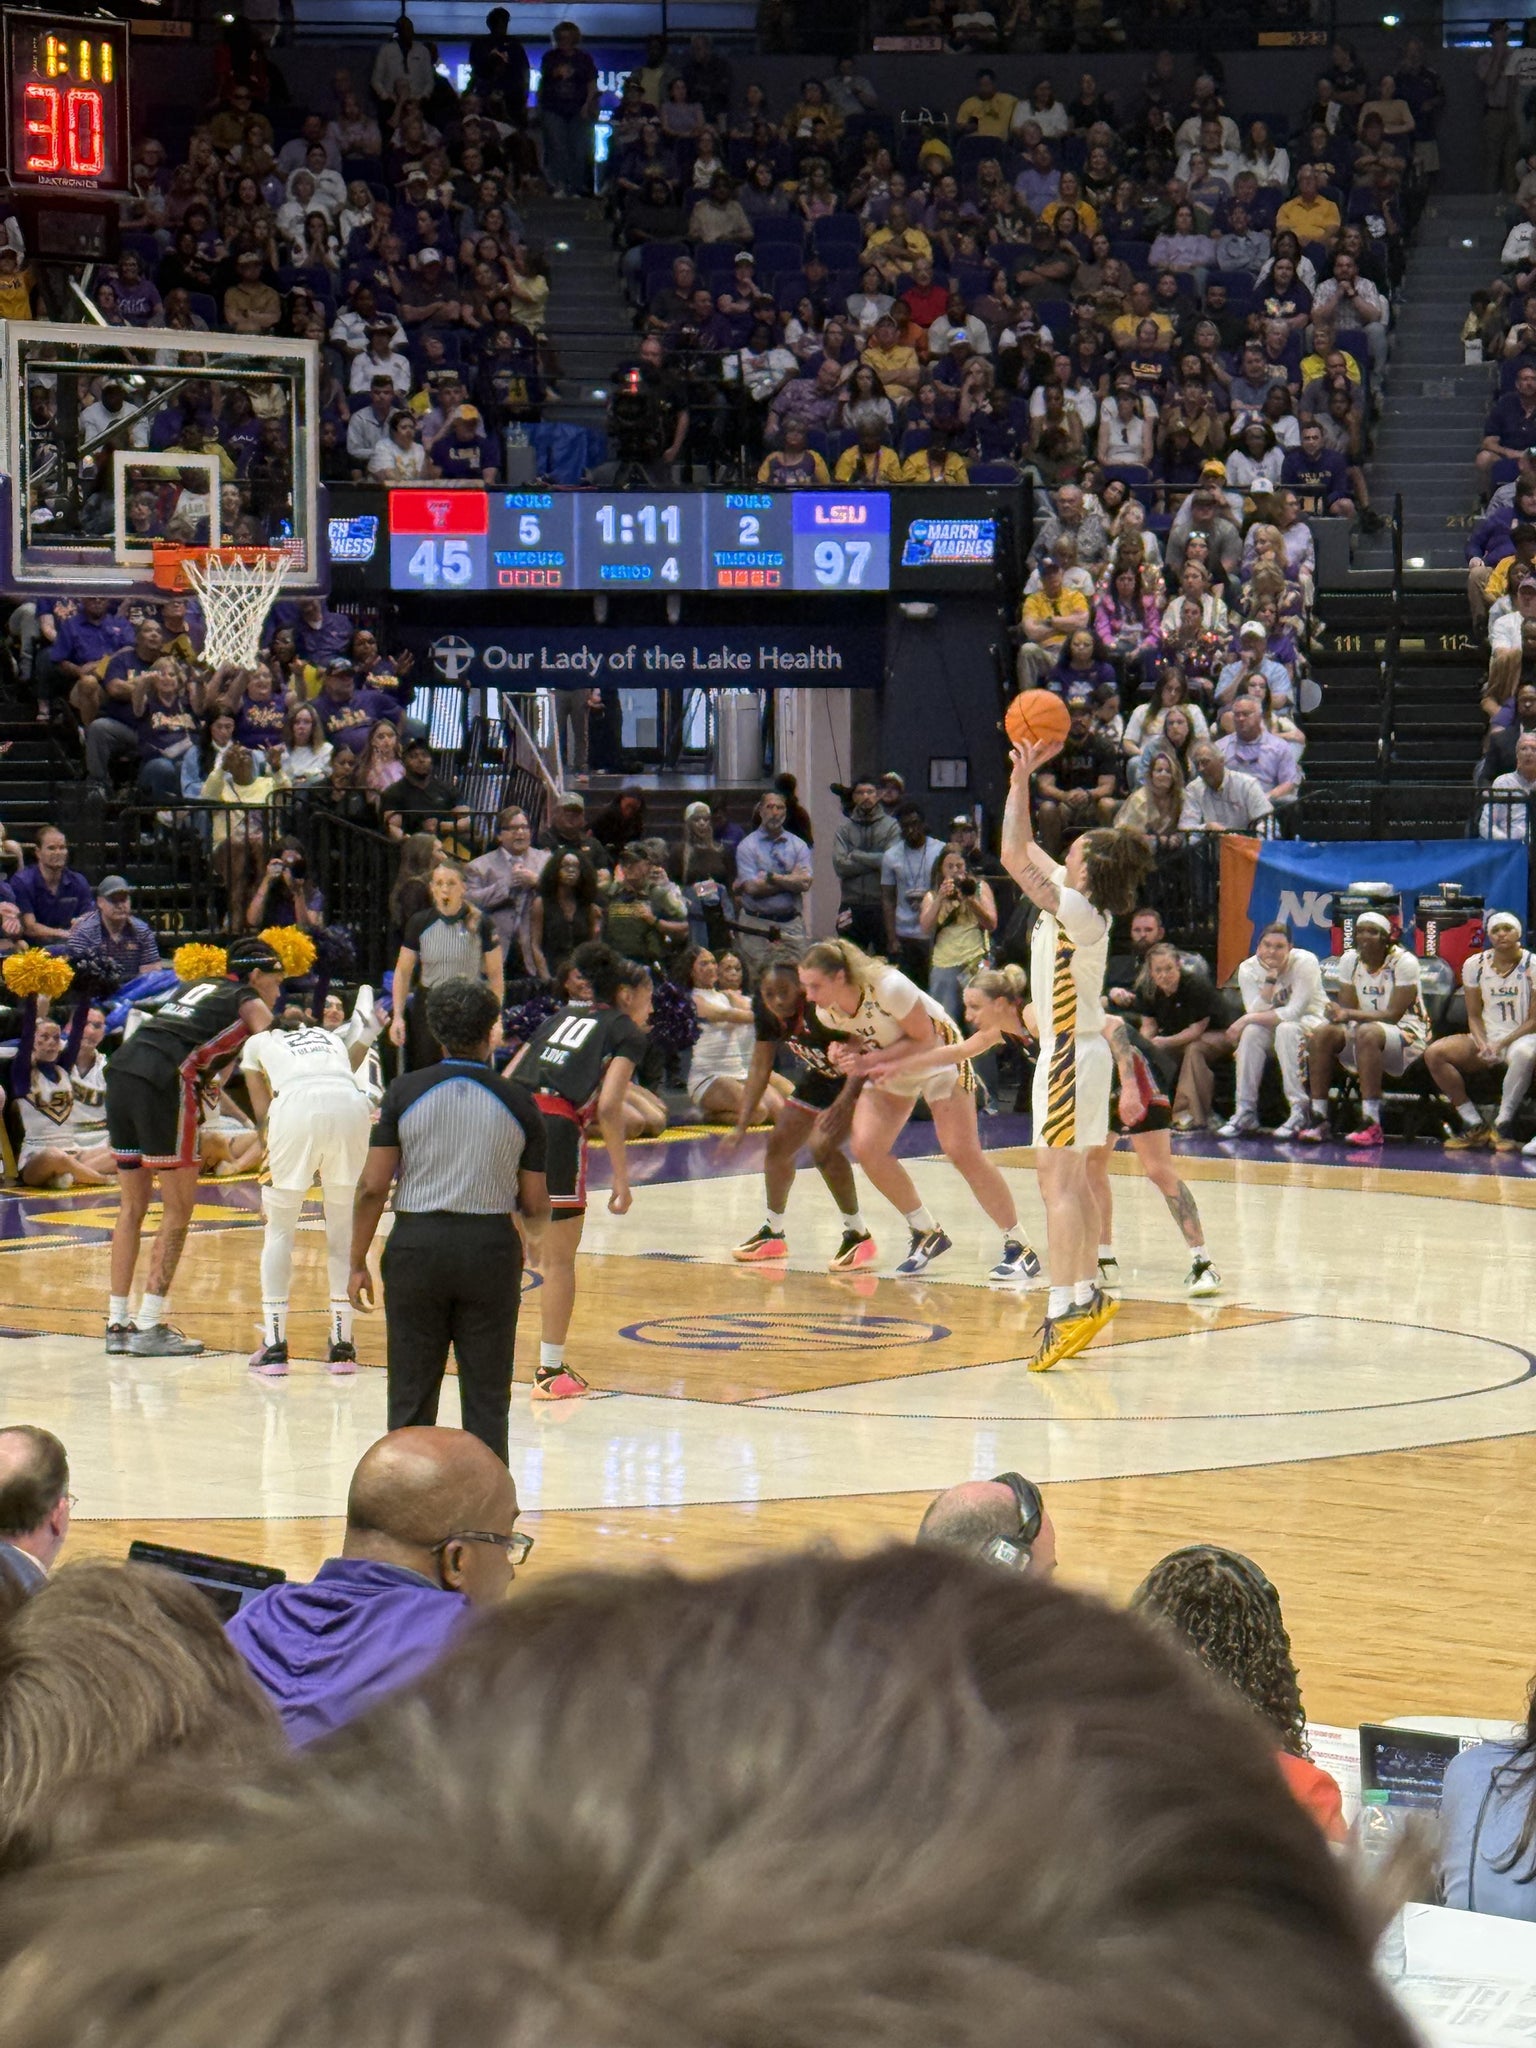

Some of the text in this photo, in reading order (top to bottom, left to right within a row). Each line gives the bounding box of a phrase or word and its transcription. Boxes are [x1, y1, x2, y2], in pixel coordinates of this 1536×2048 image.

[46, 36, 113, 84] 1:11
[25, 82, 105, 176] 30
[38, 174, 99, 189] DAKTRONICS
[504, 494, 553, 509] FOULS
[724, 494, 773, 509] FOULS
[815, 504, 867, 525] LSU
[518, 514, 541, 546] 5
[595, 504, 681, 545] 1:11
[738, 514, 761, 546] 2
[927, 523, 979, 540] MARCH
[408, 539, 474, 586] 45
[493, 551, 565, 566] TIMEOUTS
[600, 556, 681, 584] PERIOD 4
[713, 551, 785, 567] TIMEOUTS
[813, 541, 873, 586] 97
[483, 644, 842, 677] Our Lady of the Lake Health
[177, 983, 217, 1006] 0
[1496, 1001, 1517, 1024] 11
[547, 1015, 598, 1049] 10
